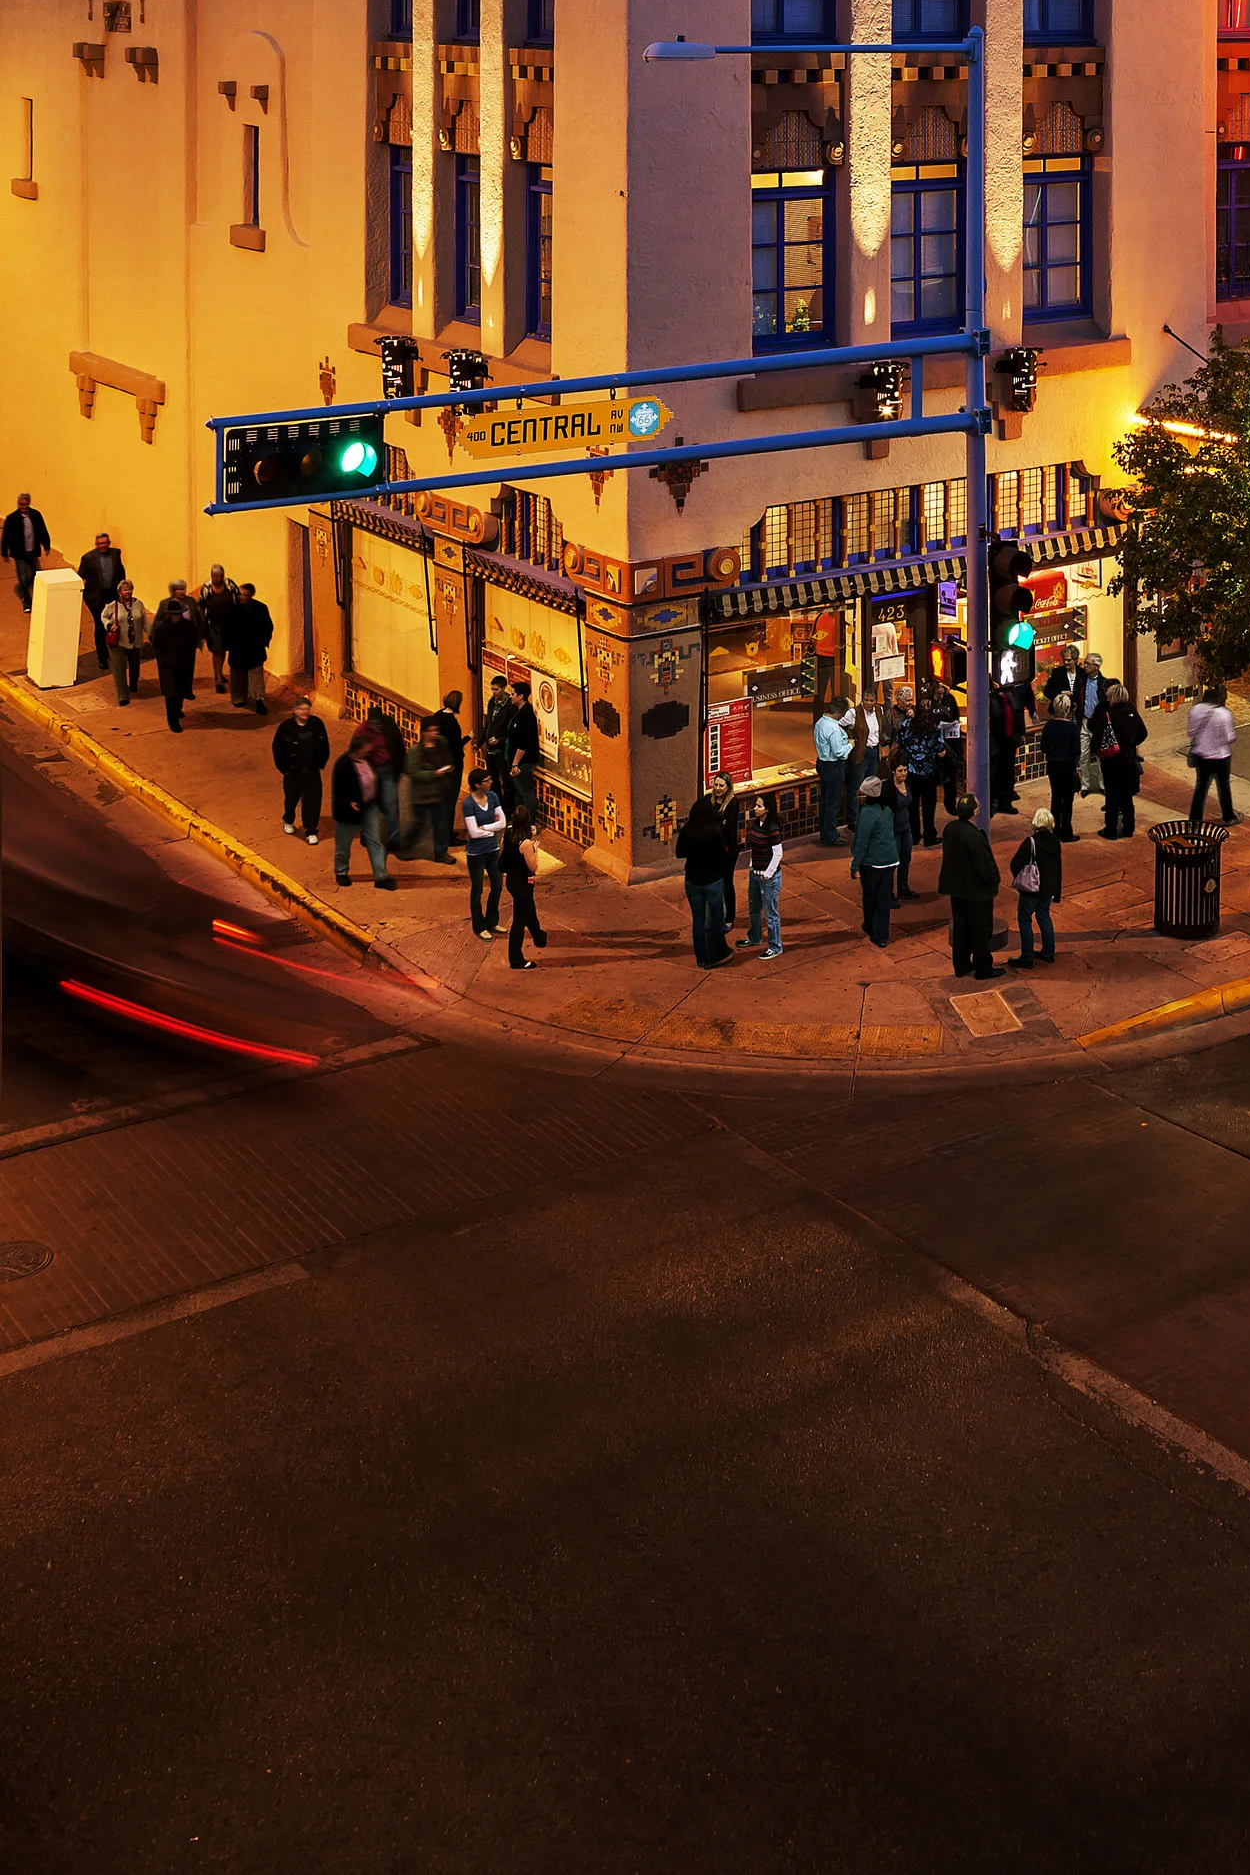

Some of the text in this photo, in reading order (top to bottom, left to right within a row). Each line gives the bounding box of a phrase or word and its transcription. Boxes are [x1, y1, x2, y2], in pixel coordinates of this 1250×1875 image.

[637, 414, 651, 425] 66
[466, 409, 623, 447] 400 CENTRAL AV
[610, 423, 623, 434] NW
[878, 604, 905, 622] 423
[1033, 636, 1051, 645] ICKET
[752, 687, 801, 703] USINESS OFFICE
